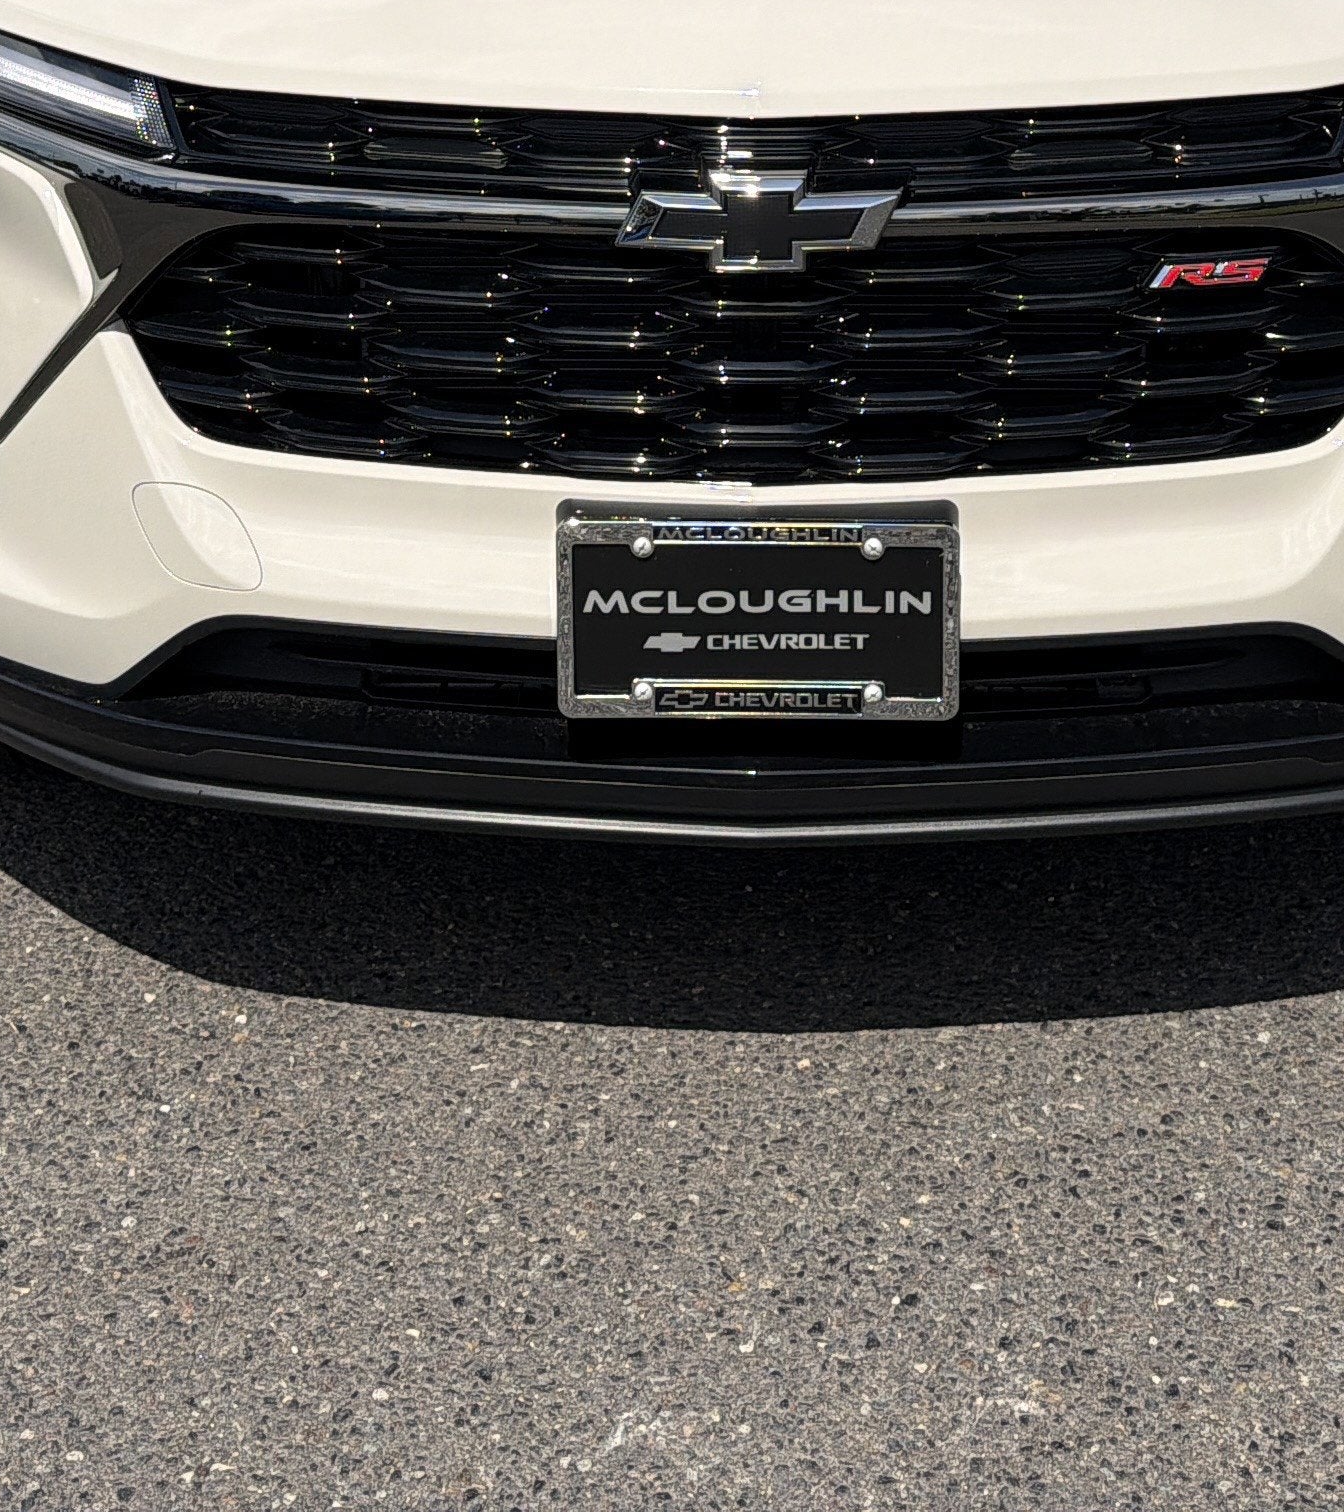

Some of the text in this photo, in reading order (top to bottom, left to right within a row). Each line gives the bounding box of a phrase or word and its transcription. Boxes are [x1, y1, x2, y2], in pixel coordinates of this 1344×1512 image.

[1149, 257, 1272, 289] RS
[657, 526, 858, 541] MCLOUGHLIN
[583, 589, 932, 615] MCLOUGHLIN
[706, 633, 871, 650] CHEVROLET
[714, 692, 858, 708] CHEVROLET
